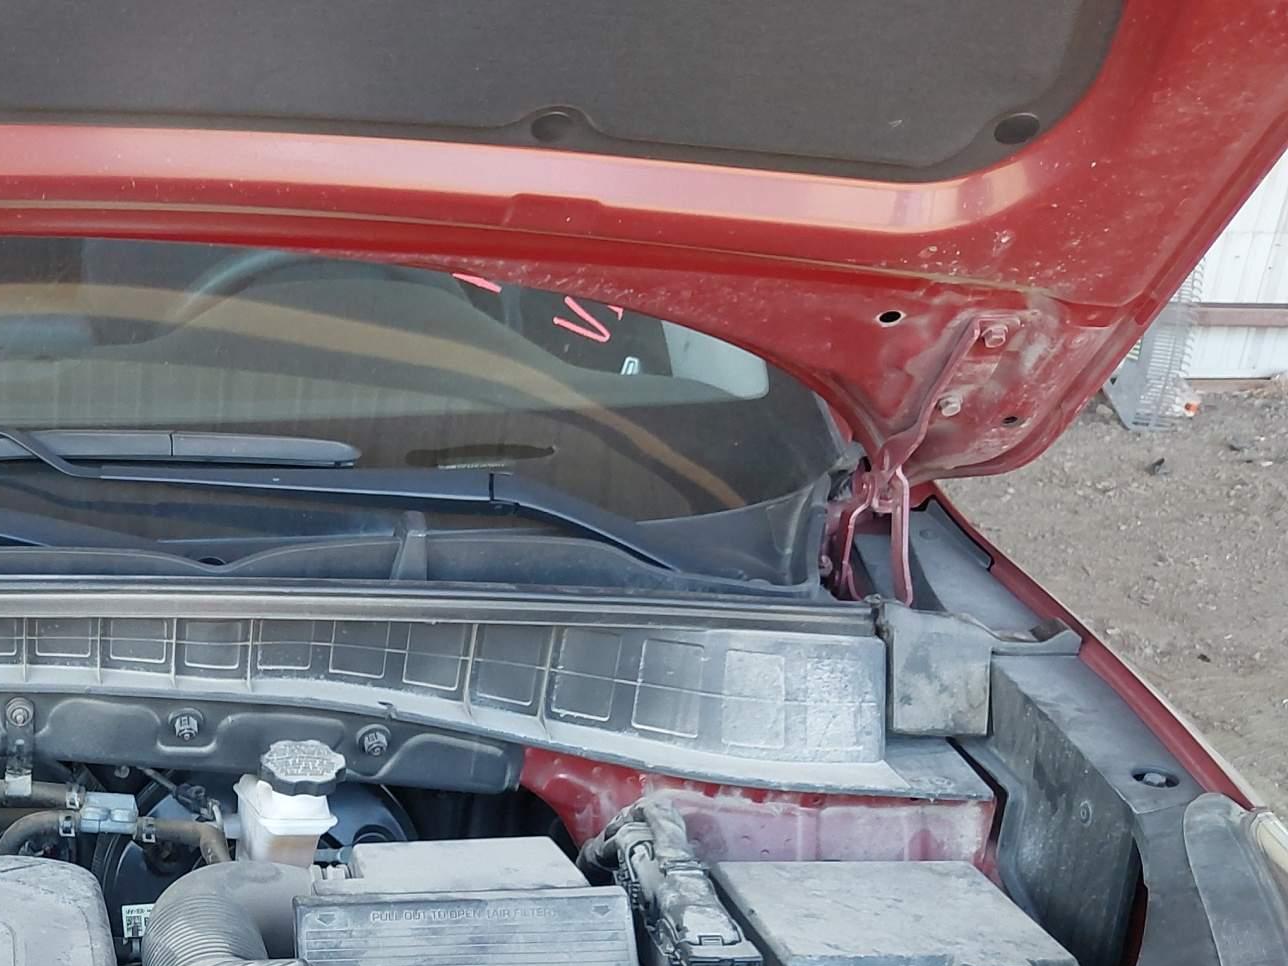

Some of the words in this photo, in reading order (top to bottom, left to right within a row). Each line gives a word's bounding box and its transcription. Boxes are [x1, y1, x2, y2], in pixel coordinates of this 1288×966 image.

[370, 910, 399, 922] PULL
[403, 909, 427, 921] OUT
[431, 909, 448, 921] TO
[449, 908, 481, 920] OPEN
